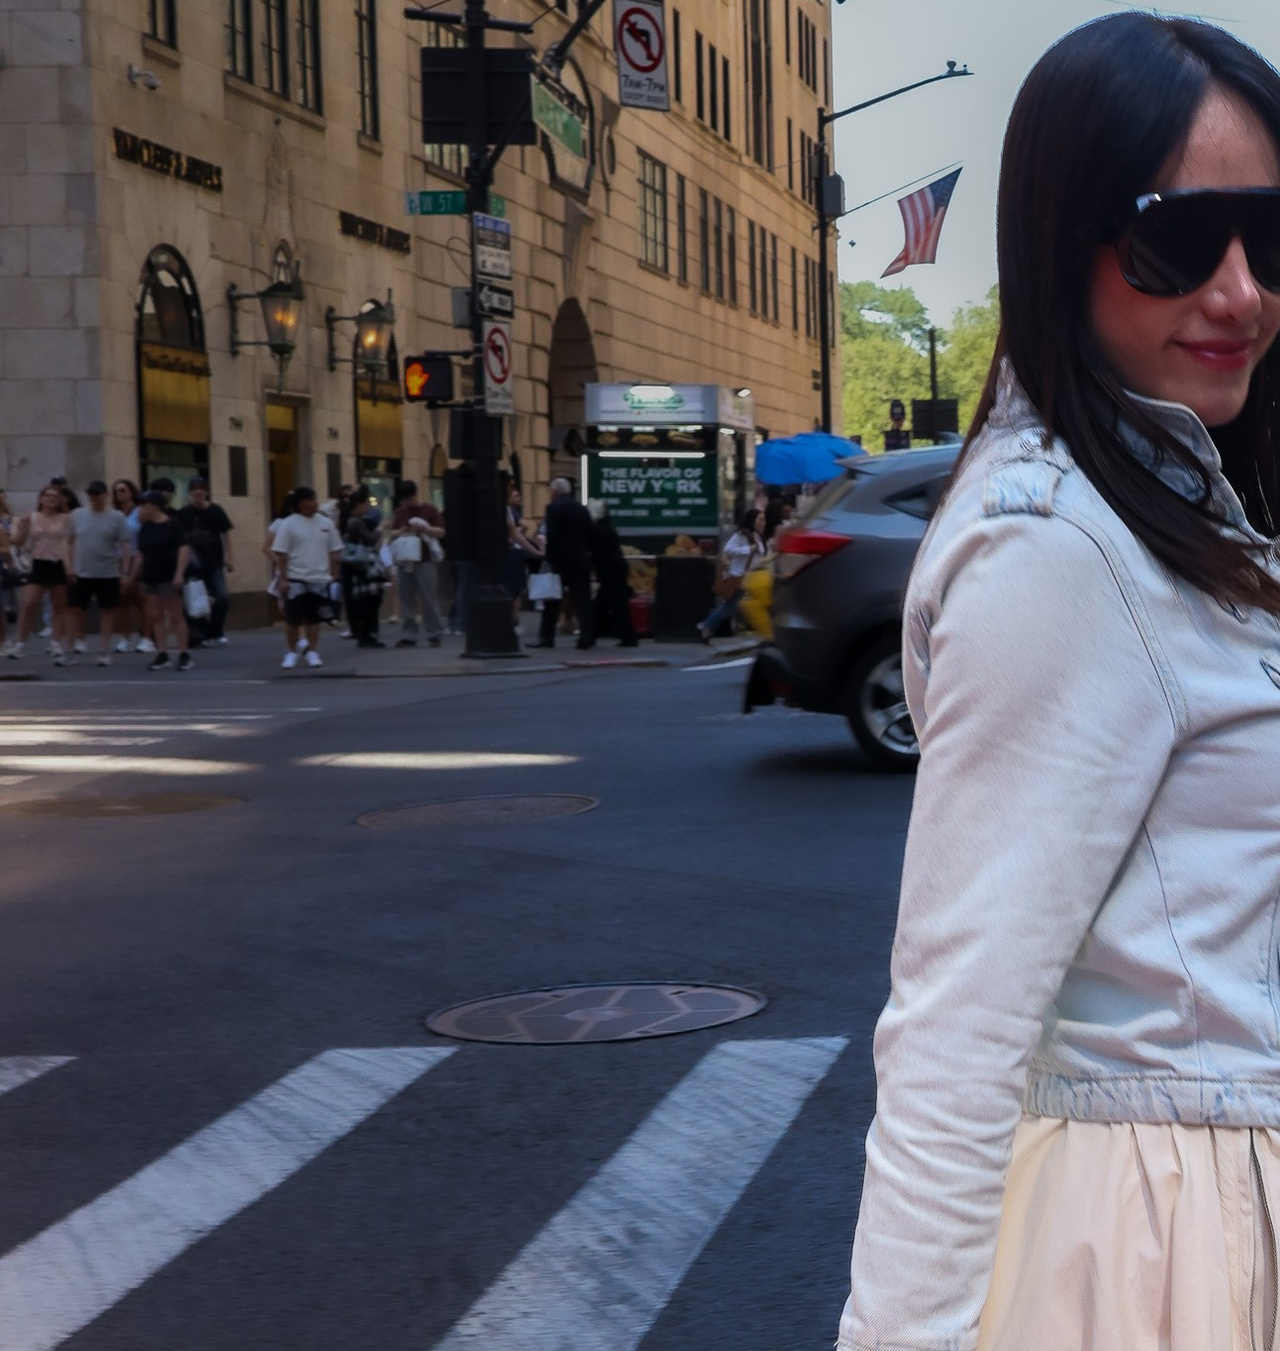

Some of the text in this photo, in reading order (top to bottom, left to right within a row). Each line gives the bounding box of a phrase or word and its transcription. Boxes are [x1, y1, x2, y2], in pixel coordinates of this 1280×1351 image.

[602, 468, 703, 479] THE FLAVOR OF
[602, 479, 703, 494] NEW YRK
